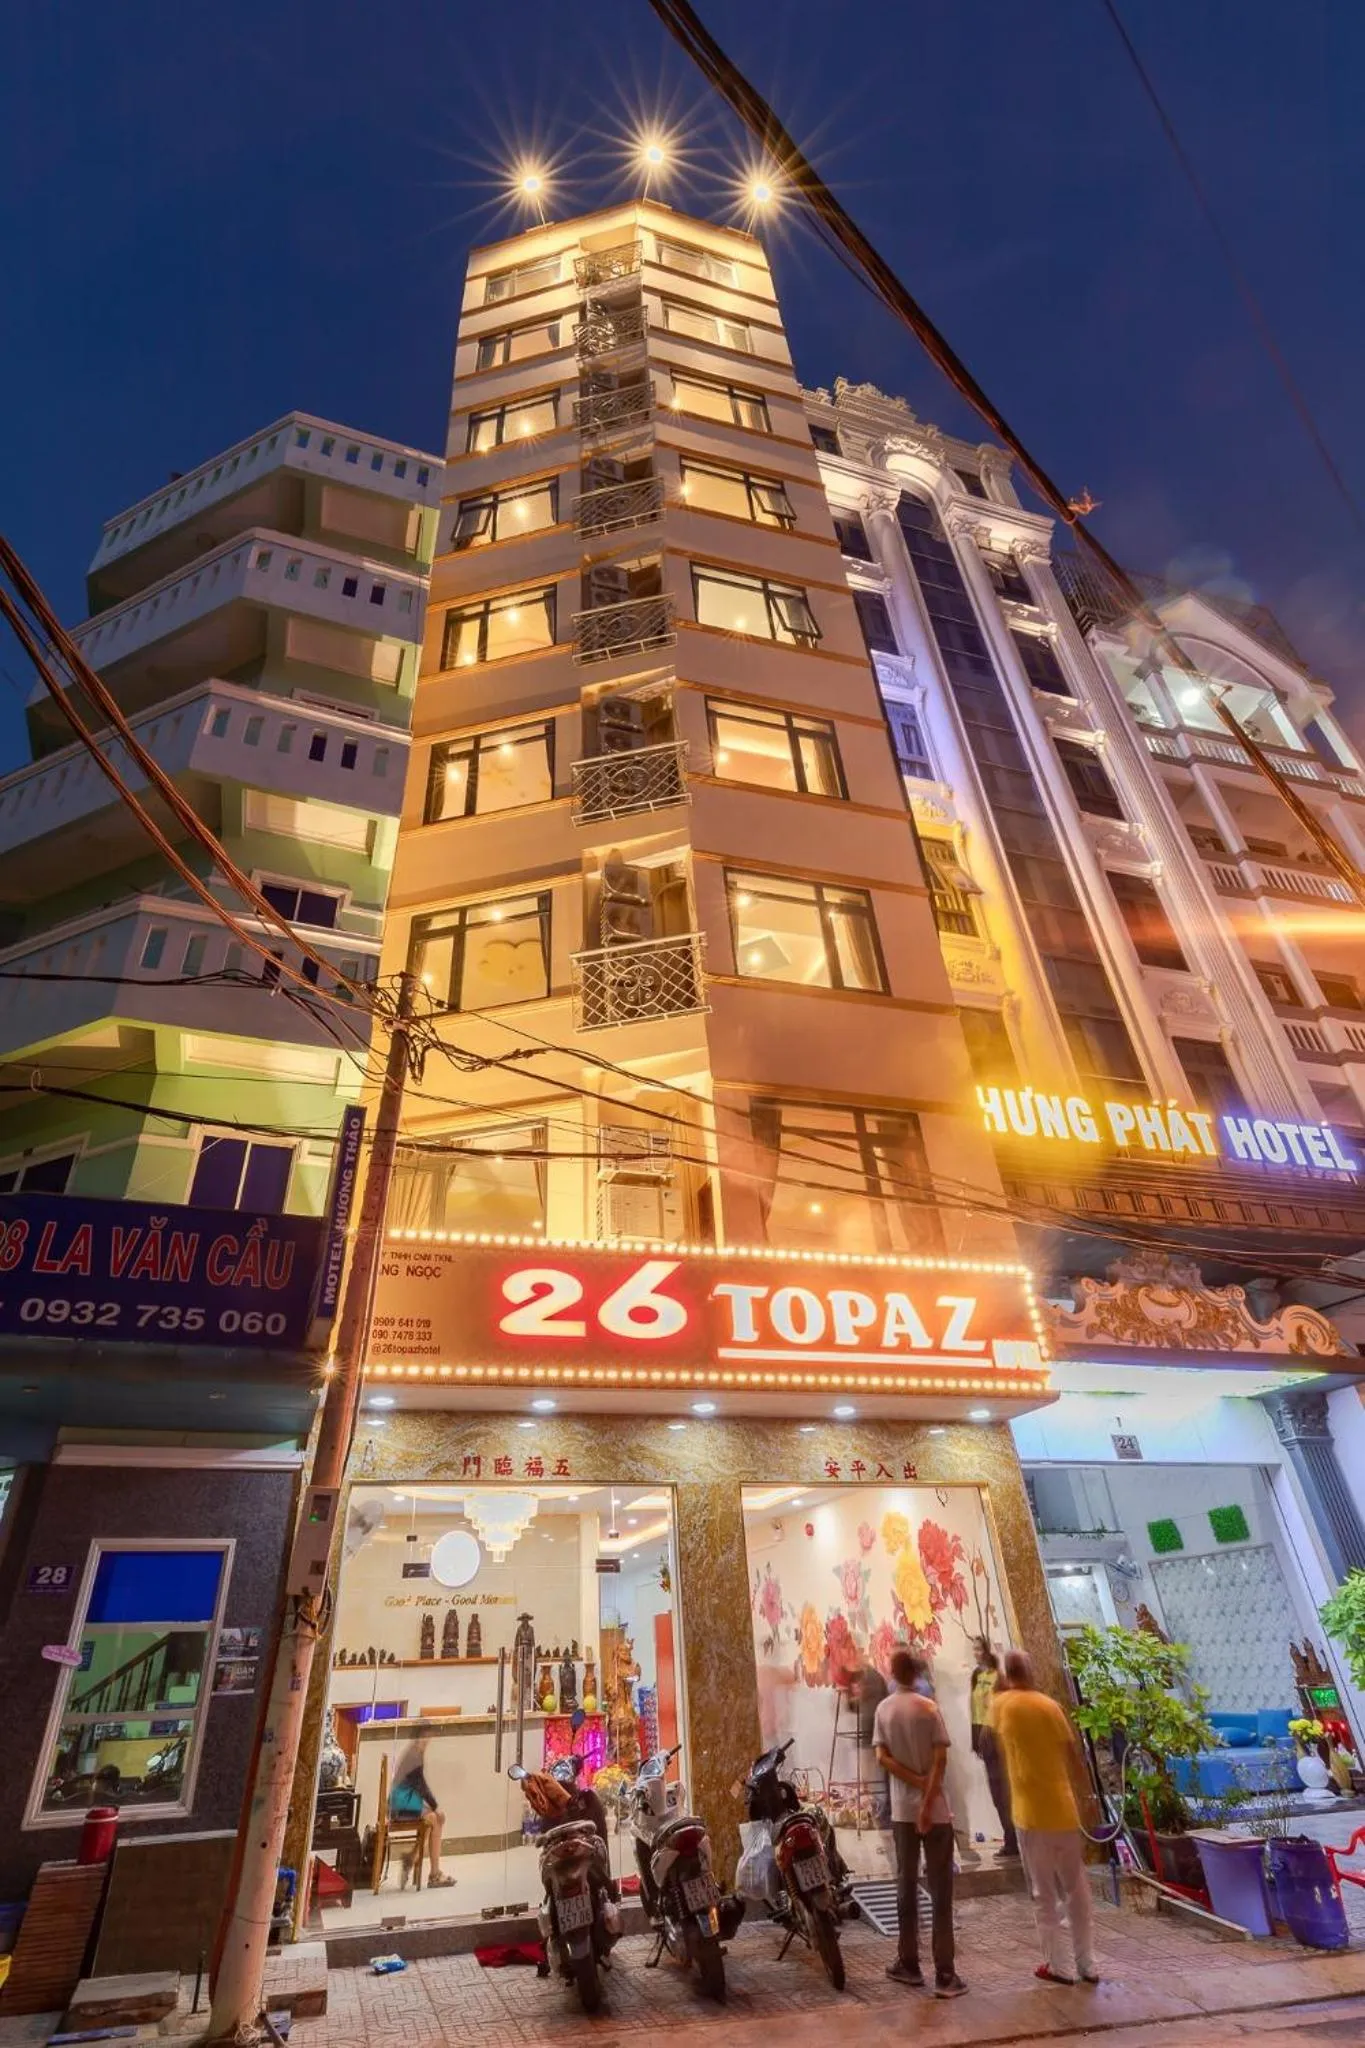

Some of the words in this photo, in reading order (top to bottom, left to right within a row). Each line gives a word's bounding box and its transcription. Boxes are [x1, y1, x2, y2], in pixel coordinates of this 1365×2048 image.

[976, 1085, 1100, 1143] HƯNG
[1104, 1099, 1217, 1156] PHÁT
[1223, 1116, 1357, 1171] HOTEL
[0, 1219, 29, 1271] 8
[32, 1221, 93, 1276] LA
[110, 1216, 199, 1282] VĂN
[206, 1218, 296, 1290] CẦU
[323, 1236, 342, 1305] MOTEL
[380, 1264, 399, 1276] NG
[406, 1265, 441, 1280] NGỌC
[20, 1298, 121, 1326] 0932
[136, 1304, 205, 1330] 735
[219, 1309, 286, 1335] 060
[499, 1261, 687, 1339] 26
[713, 1284, 988, 1352] TOPAZ
[1119, 1437, 1135, 1449] 24
[36, 1566, 67, 1585] 28
[451, 1594, 478, 1606] Good
